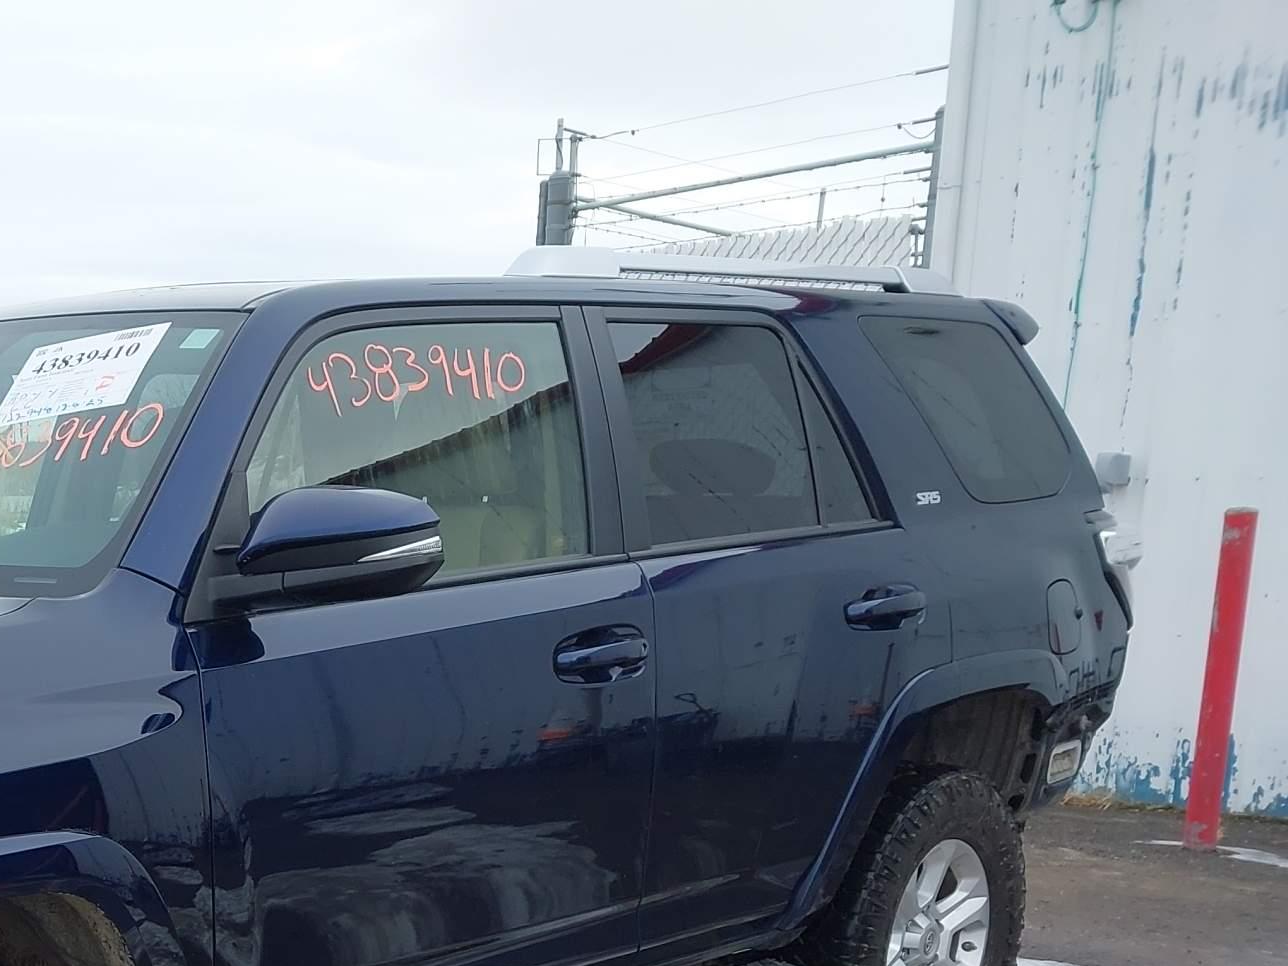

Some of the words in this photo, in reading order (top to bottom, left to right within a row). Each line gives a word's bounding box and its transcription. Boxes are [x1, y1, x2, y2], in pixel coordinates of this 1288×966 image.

[32, 342, 141, 374] 43839410
[307, 343, 526, 417] 43839410
[916, 491, 941, 504] SR5
